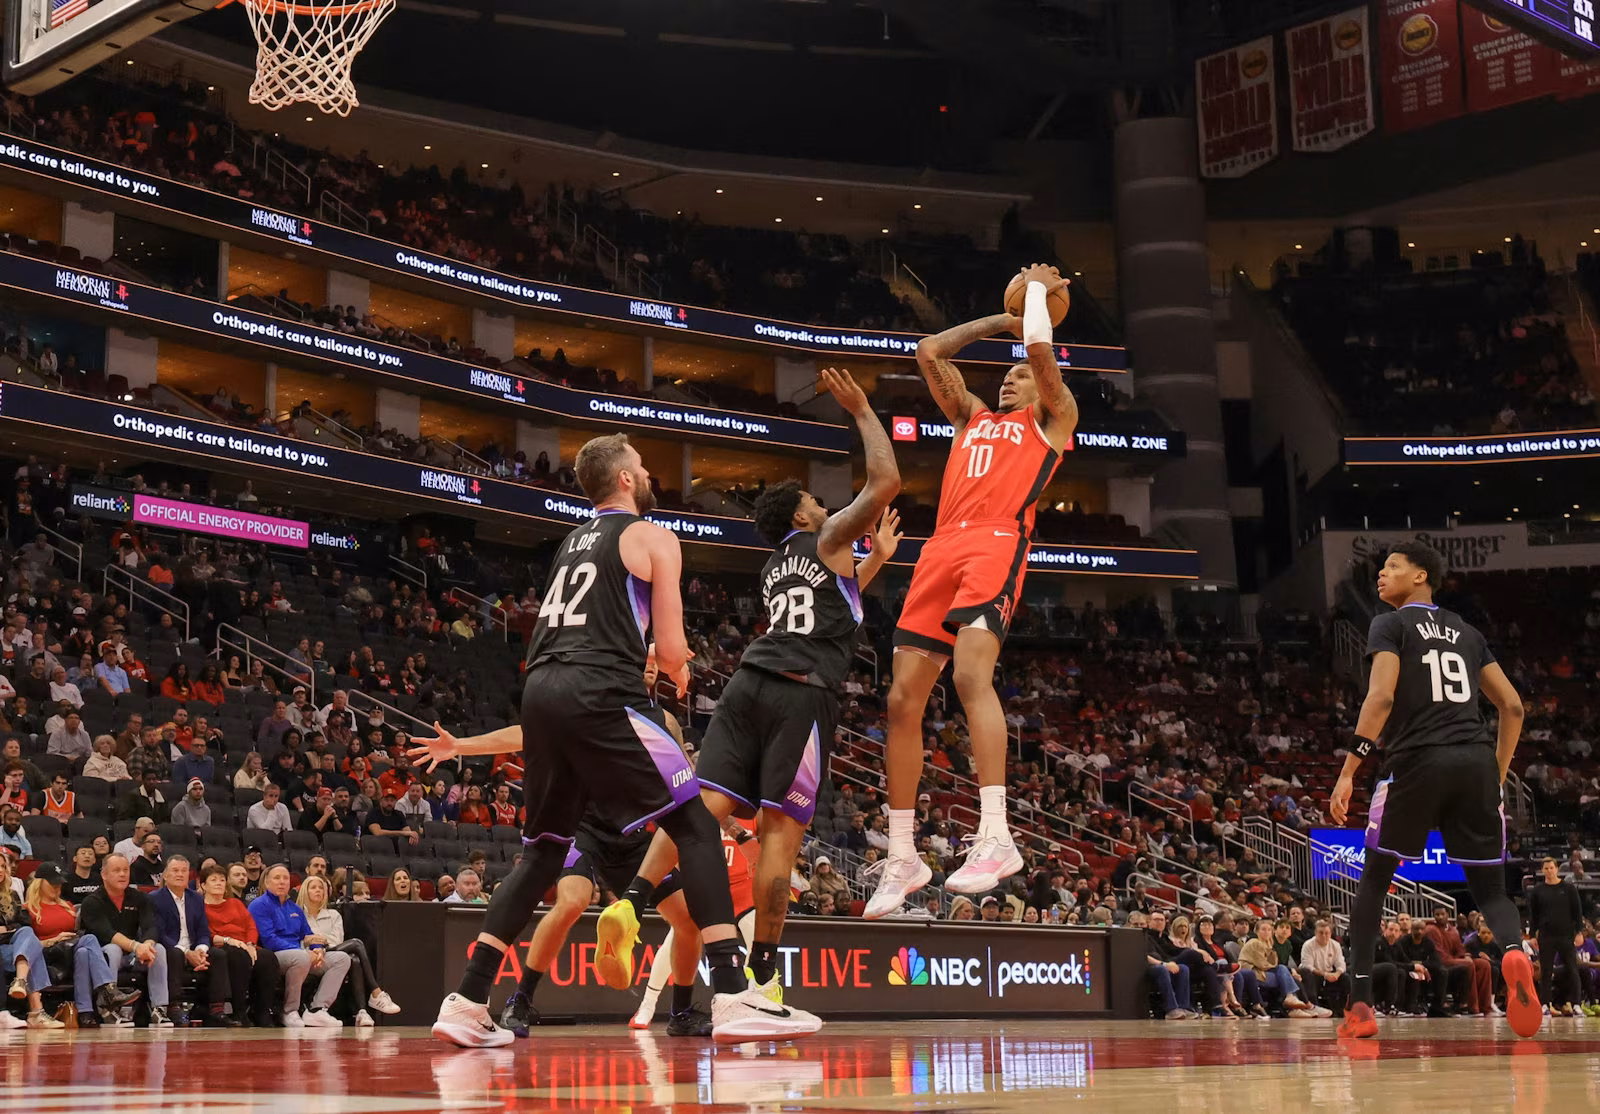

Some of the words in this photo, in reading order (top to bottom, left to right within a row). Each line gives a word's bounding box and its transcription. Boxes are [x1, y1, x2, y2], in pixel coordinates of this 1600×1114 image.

[29, 154, 57, 168] care
[61, 160, 113, 183] tailored
[116, 175, 130, 187] to
[133, 182, 159, 196] you.
[251, 216, 296, 235] HERMANN
[252, 208, 296, 227] MEMORIAL
[56, 270, 110, 288] MEMORIAL
[396, 253, 455, 277] Orthopedic
[457, 272, 478, 283] care
[480, 276, 520, 295] tailored
[522, 287, 535, 297] to
[537, 291, 561, 302] you.
[56, 279, 110, 299] HERMANN
[100, 298, 129, 310] Orthopedics
[630, 301, 672, 314] MEMORIAL
[630, 307, 672, 320] HERMANN
[213, 312, 283, 338] Orthopedic
[286, 332, 311, 345] care
[315, 336, 362, 357] tailored
[364, 348, 376, 360] to
[379, 354, 402, 366] you.
[755, 324, 813, 342] Orthopedic
[815, 336, 839, 344] care
[841, 335, 886, 348] tailored
[887, 338, 902, 349] to
[904, 341, 918, 352] yo
[470, 370, 511, 386] MEMORIAL
[470, 376, 511, 393] HERMANN
[590, 400, 655, 418] Orthopedic
[658, 411, 682, 421] care
[684, 412, 729, 428] tailored
[731, 420, 743, 429] to
[746, 423, 769, 433] you.
[114, 414, 193, 442] Orthopedic
[197, 433, 225, 446] care
[229, 434, 282, 458] tailored
[285, 448, 298, 460] to
[301, 453, 328, 466] you.
[920, 423, 955, 438] TUND
[1077, 434, 1128, 447] TUNDRA
[1132, 437, 1167, 449] ZONE
[1403, 445, 1473, 457] Orthopedic
[1475, 444, 1504, 455] care
[1507, 439, 1560, 452] tailored
[1563, 439, 1577, 448] to
[967, 444, 993, 478] 10
[421, 470, 465, 485] MEMORIAL
[421, 478, 465, 494] HERMANN
[74, 493, 115, 511] reliant
[140, 504, 196, 523] OFFICIAL
[199, 513, 248, 530] ENERGY
[247, 520, 303, 540] PROVIDER
[545, 498, 597, 519] Orthoped
[682, 521, 695, 532] to
[698, 525, 722, 536] you.
[312, 532, 347, 548] reliant
[1027, 551, 1074, 564] tailored
[1076, 554, 1089, 564] to
[1091, 556, 1117, 567] you.
[538, 562, 597, 627] 42
[766, 585, 815, 635] 28
[1416, 622, 1460, 644] BAILEY
[1422, 649, 1471, 702] 19
[672, 767, 693, 788] UTAH
[787, 789, 811, 808] UTAH
[1324, 844, 1365, 864] Mich
[802, 948, 871, 988] LIVE
[931, 958, 981, 986] NBC
[998, 954, 1083, 997] peacock
